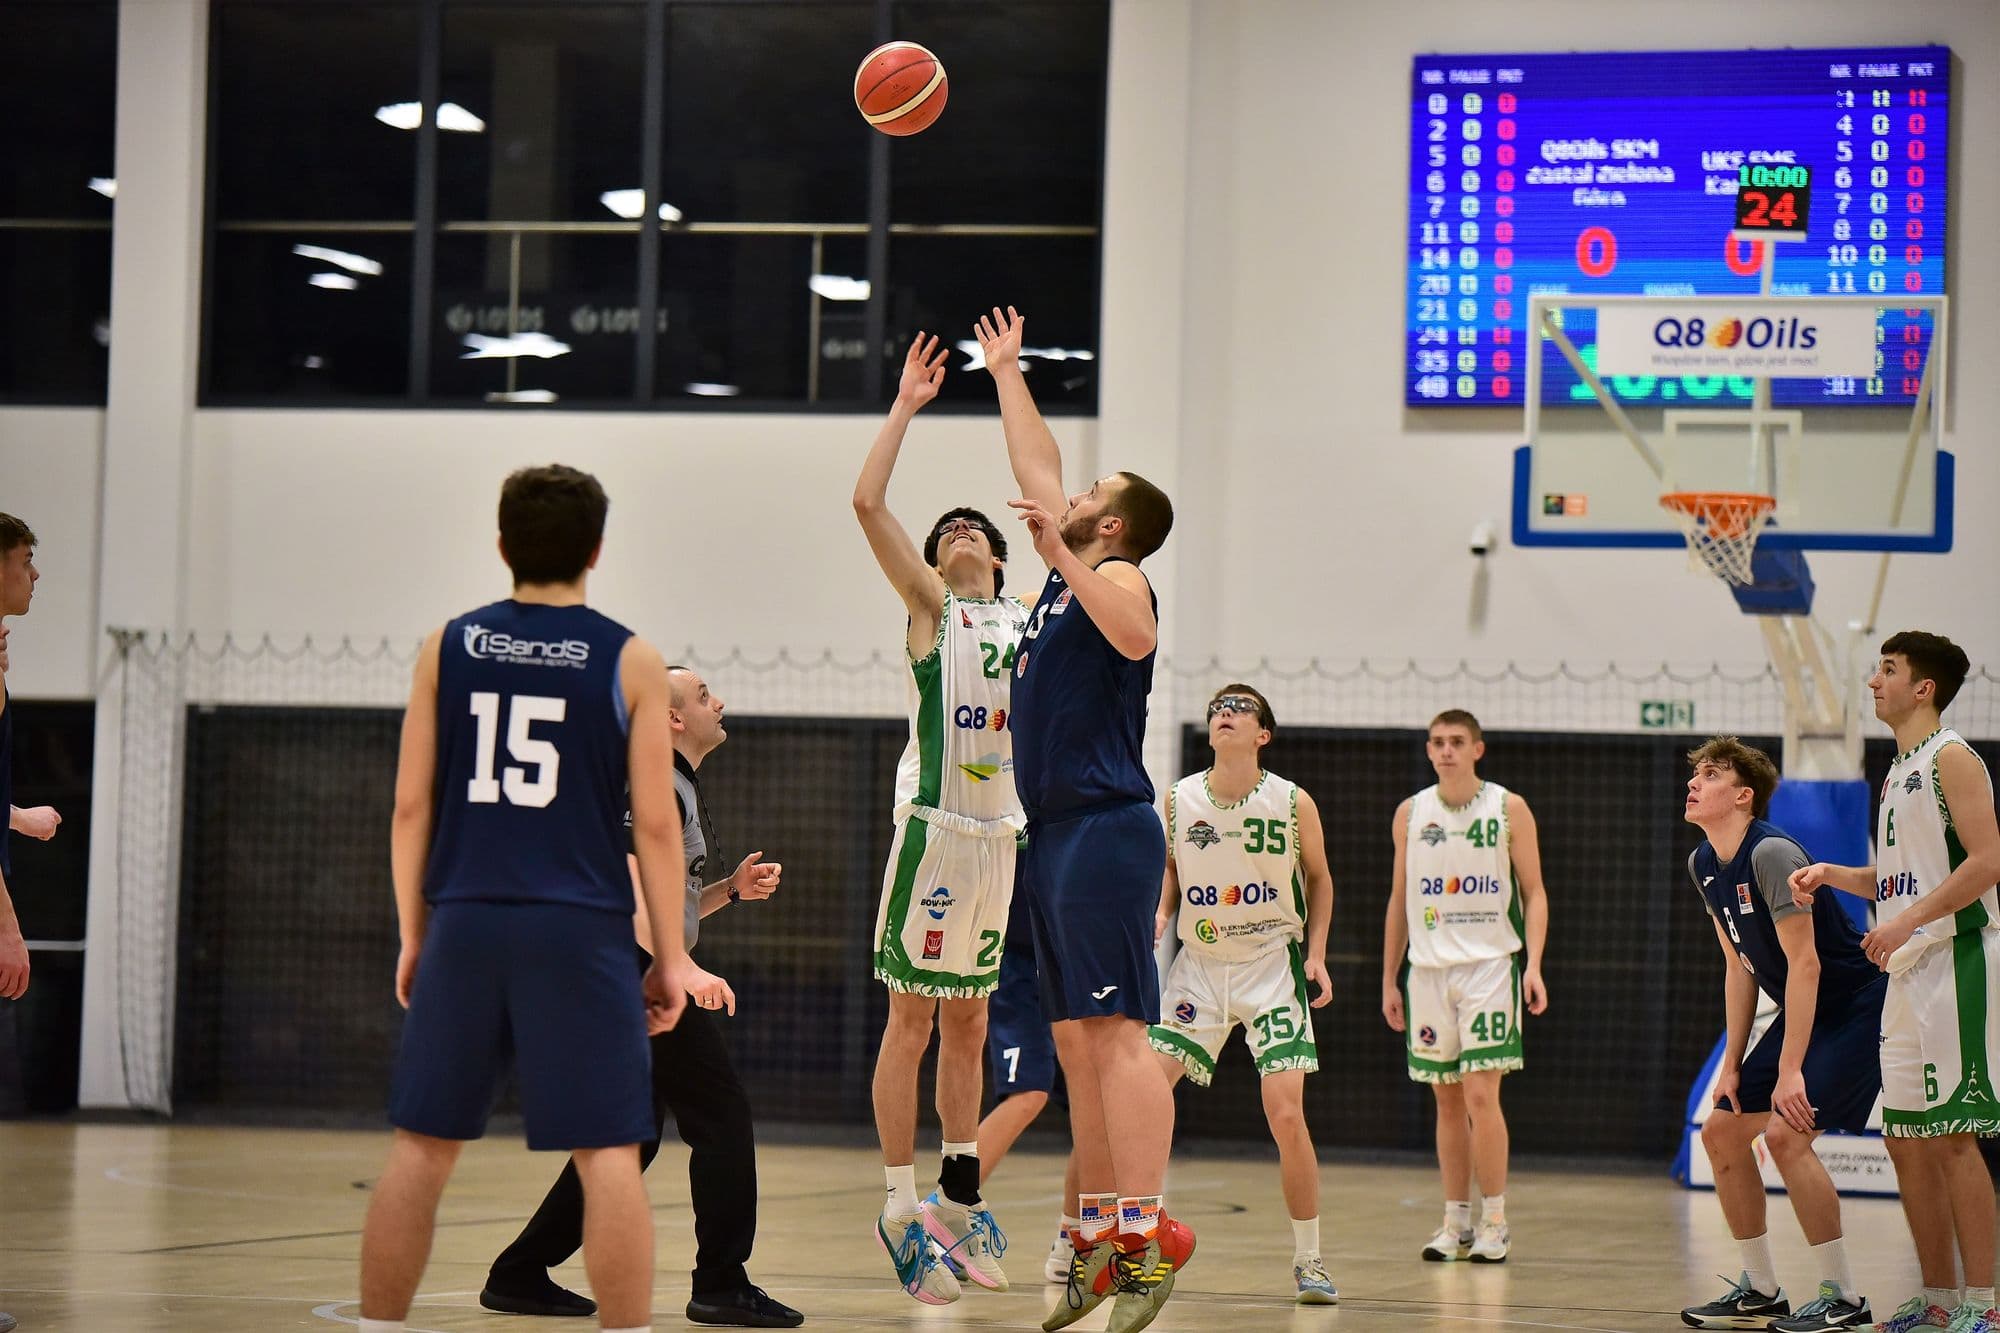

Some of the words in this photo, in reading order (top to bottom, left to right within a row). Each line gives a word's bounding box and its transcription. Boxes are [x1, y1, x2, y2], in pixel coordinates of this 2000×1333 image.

[1428, 93, 1448, 115] 0
[1463, 93, 1483, 115] 0
[1428, 119, 1447, 141] 2
[1462, 119, 1482, 141] 0
[1836, 114, 1854, 135] 4
[1872, 114, 1890, 135] 0
[1908, 114, 1926, 135] 0
[1428, 144, 1447, 167] 5
[1462, 144, 1482, 167] 0
[1835, 140, 1853, 161] 5
[1871, 140, 1889, 161] 0
[1908, 140, 1926, 161] 0
[1426, 170, 1446, 193] 6
[1461, 170, 1481, 193] 0
[1739, 165, 1808, 188] 10:00
[1834, 166, 1853, 188] 6
[1871, 166, 1889, 188] 0
[1907, 166, 1925, 188] 0
[1426, 196, 1446, 218] 7
[1460, 196, 1480, 218] 0
[1741, 191, 1798, 226] 24
[1834, 192, 1852, 214] 7
[1870, 192, 1888, 214] 0
[1906, 192, 1924, 214] 0
[1420, 222, 1450, 244] 11
[1460, 222, 1480, 244] 0
[1833, 218, 1851, 241] 8
[1869, 218, 1887, 241] 0
[1906, 218, 1924, 241] 0
[1420, 247, 1450, 270] 14
[1460, 247, 1480, 270] 0
[1576, 227, 1618, 277] 0
[1827, 244, 1859, 266] 10
[1868, 244, 1886, 266] 0
[1905, 244, 1923, 266] 0
[1459, 274, 1479, 296] 0
[1827, 271, 1857, 293] 11
[1868, 271, 1886, 293] 0
[1905, 271, 1923, 293] 0
[1417, 299, 1448, 321] 21
[1459, 299, 1479, 321] 0
[1655, 318, 1705, 348] Q8
[1746, 317, 1817, 349] Oils
[1457, 350, 1477, 373] 0
[1457, 376, 1477, 398] 0
[980, 641, 1018, 679] 24
[954, 704, 987, 730] Q8
[467, 691, 567, 809] 15
[1243, 817, 1287, 855] 35
[1466, 818, 1500, 848] 48
[1187, 885, 1218, 907] Q8
[1243, 881, 1278, 905] Ois
[1420, 877, 1444, 895] Q8
[1462, 875, 1499, 895] Oils
[1723, 906, 1740, 944] 8
[1253, 1006, 1295, 1048] 35
[1471, 1011, 1506, 1041] 48
[1003, 1047, 1020, 1083] 7
[1924, 1063, 1939, 1102] 6
